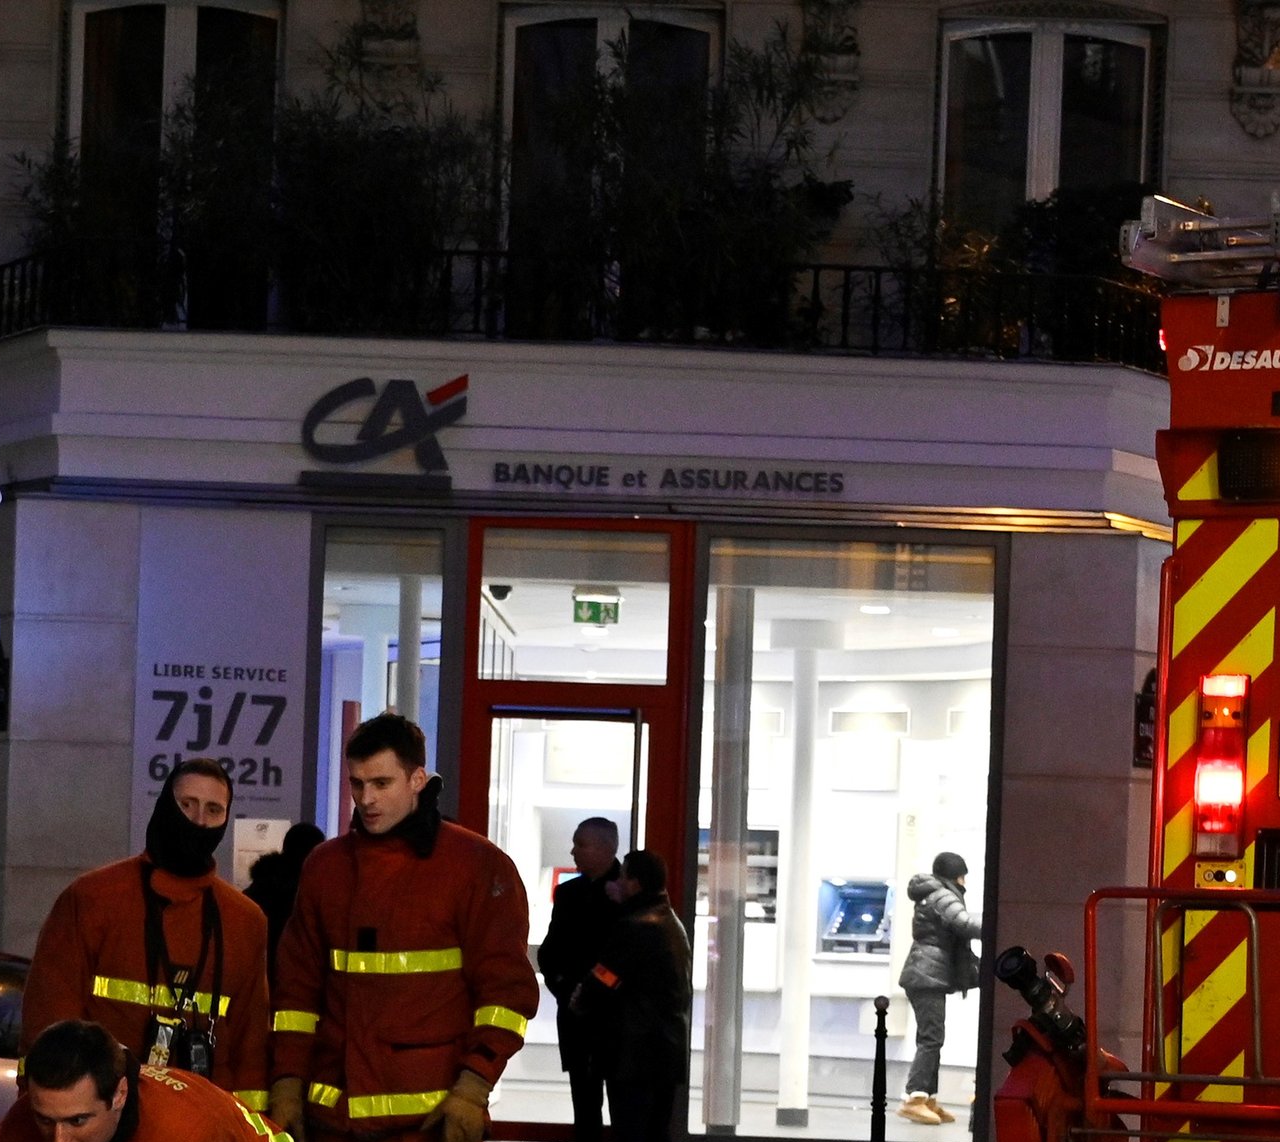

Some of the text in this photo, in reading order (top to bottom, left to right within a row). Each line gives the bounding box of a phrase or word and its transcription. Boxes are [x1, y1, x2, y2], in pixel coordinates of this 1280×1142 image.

[494, 462, 845, 494] BANQUE et ASSURANCES
[153, 663, 287, 682] LIBRE SERVICE
[152, 686, 287, 752] 7j/7
